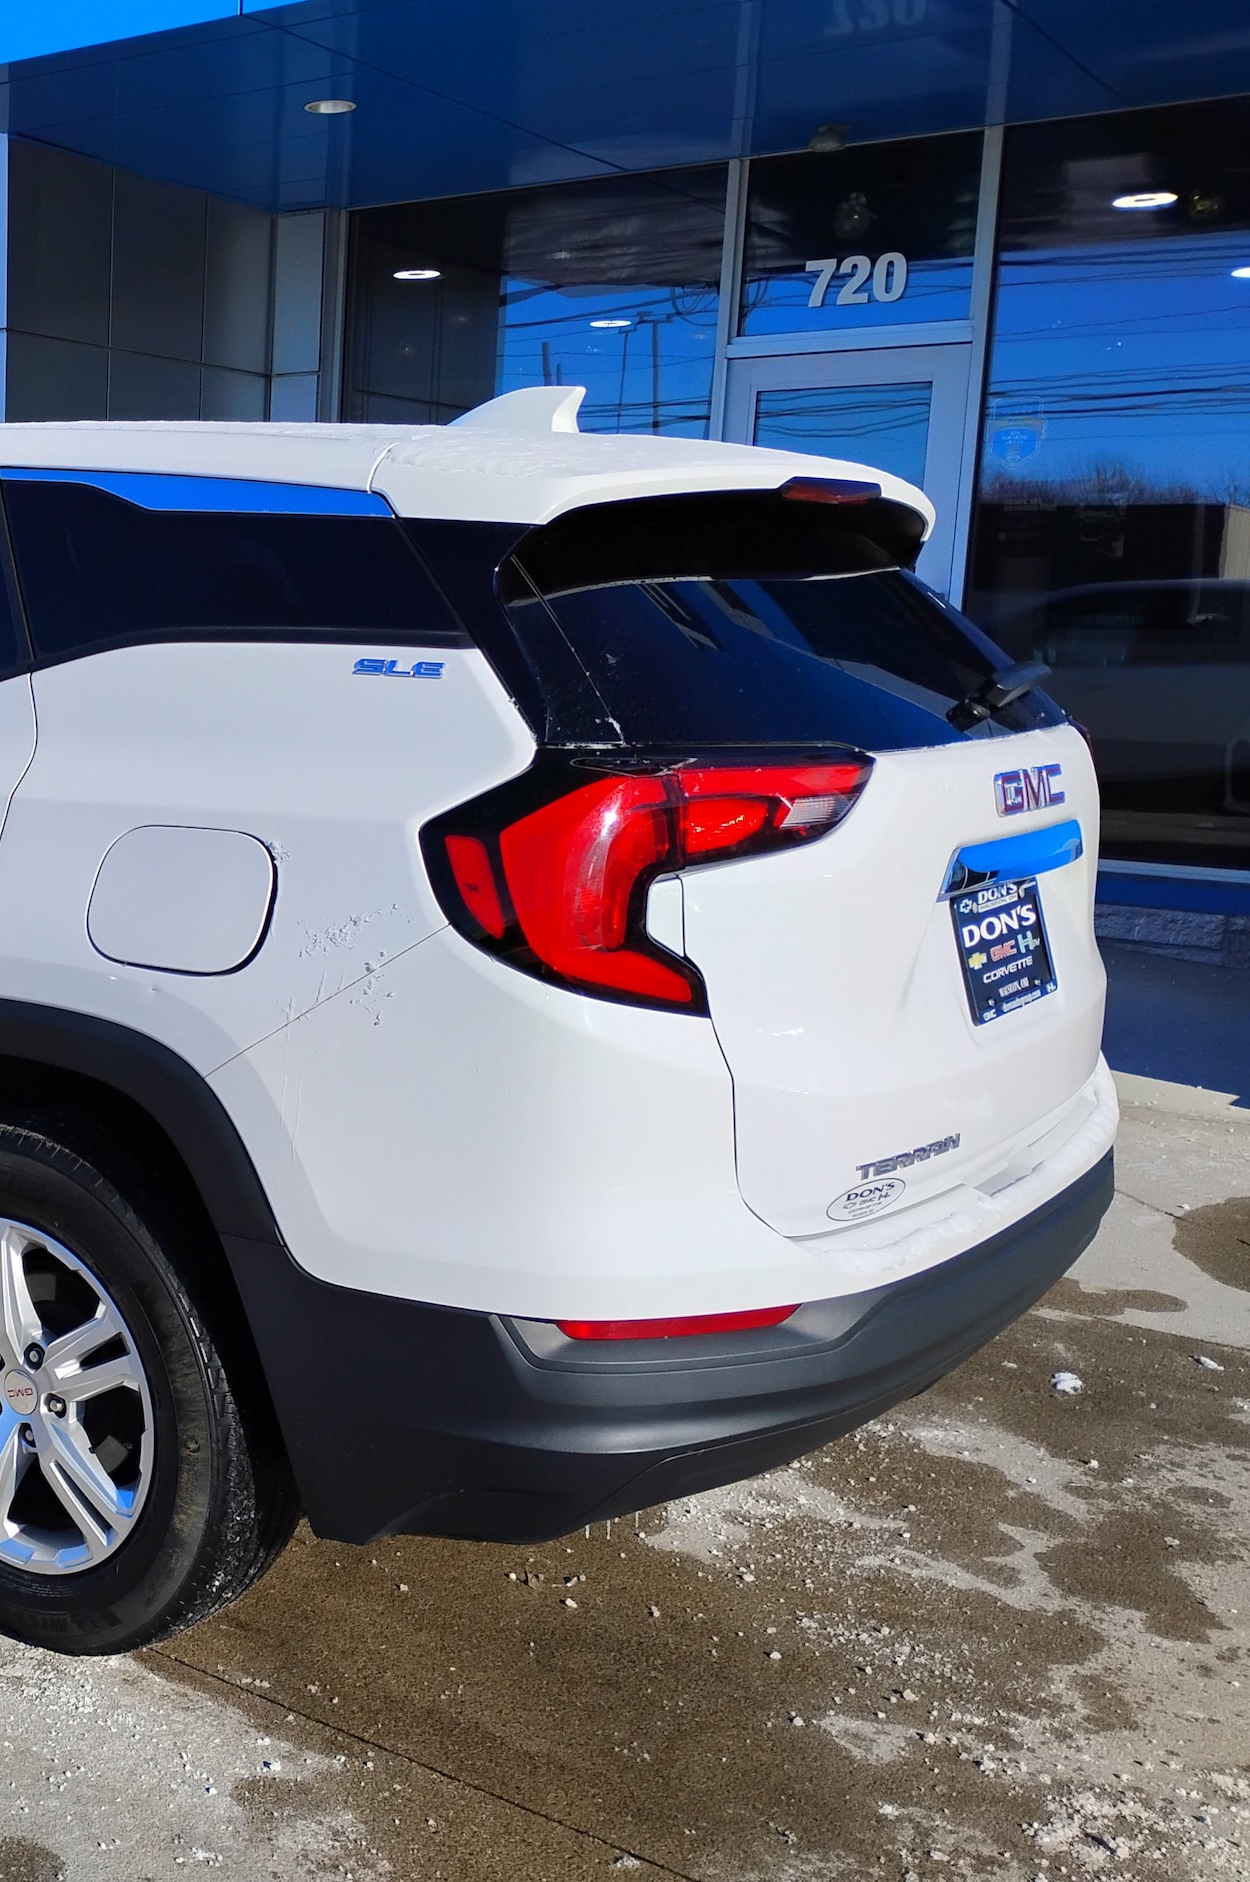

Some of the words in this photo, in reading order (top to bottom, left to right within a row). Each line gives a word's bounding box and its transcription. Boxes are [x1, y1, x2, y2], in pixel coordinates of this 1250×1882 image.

[805, 251, 908, 308] 720
[351, 658, 446, 679] SLE
[993, 763, 1067, 818] GMC
[977, 883, 1018, 905] DON'S
[961, 904, 1037, 949] DON'S
[990, 939, 1018, 962] GMC
[983, 955, 1033, 984] CORVETTE
[855, 1133, 961, 1181] TERRAIN
[845, 1181, 896, 1202] DON'S
[6, 1387, 34, 1398] GMC
